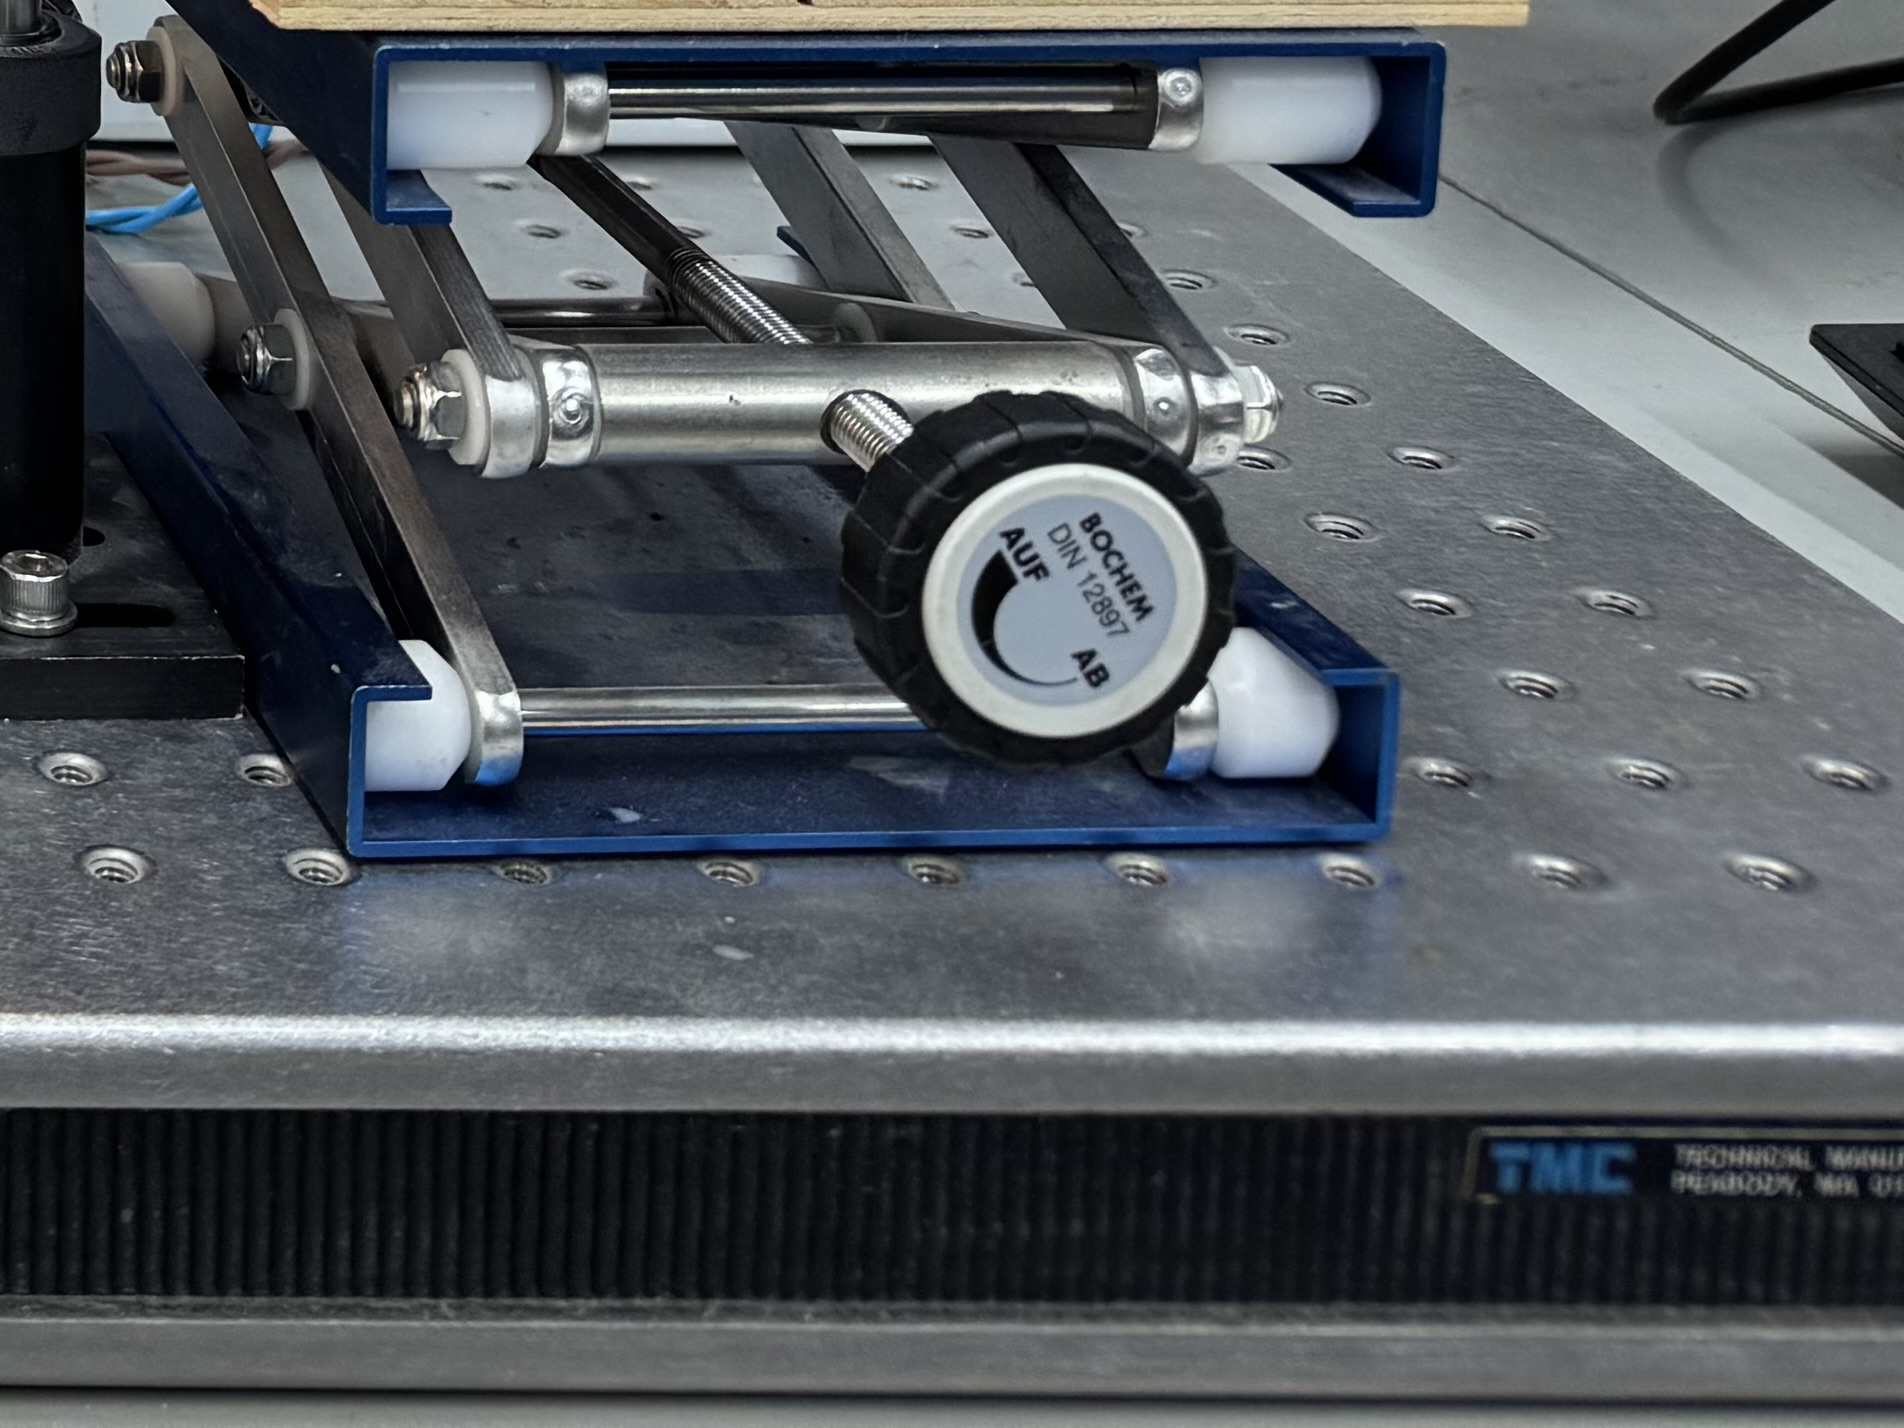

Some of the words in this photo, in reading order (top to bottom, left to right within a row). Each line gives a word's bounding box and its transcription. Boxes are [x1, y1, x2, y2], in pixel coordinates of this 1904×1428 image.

[999, 527, 1050, 583] AUF
[1047, 522, 1089, 571] DIN
[1077, 570, 1130, 637] 12897
[1079, 511, 1155, 622] BOCHEM
[1070, 648, 1110, 689] AB
[1489, 1143, 1638, 1195] TMC
